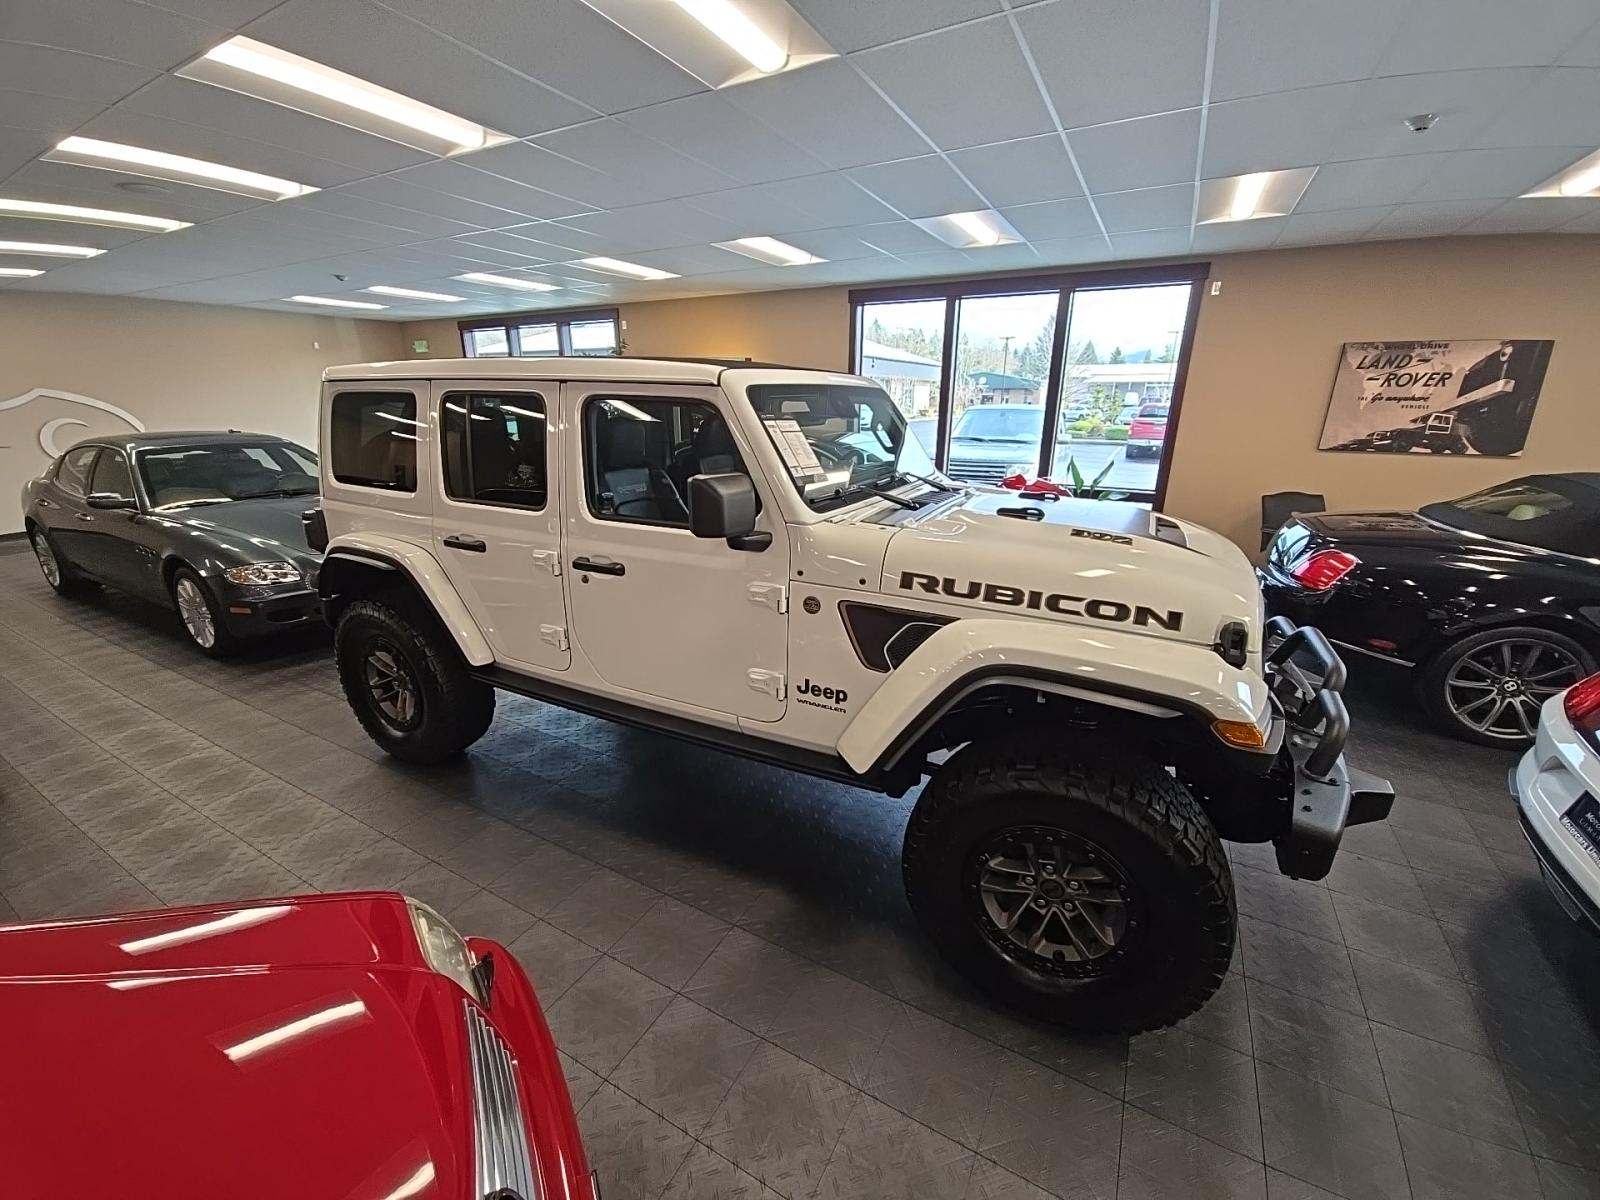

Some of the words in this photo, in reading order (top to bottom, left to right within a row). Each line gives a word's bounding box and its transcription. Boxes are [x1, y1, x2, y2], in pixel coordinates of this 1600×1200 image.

[1355, 354, 1414, 370] LAND
[1380, 372, 1453, 388] ROVER
[899, 571, 1184, 632] RUBICON
[796, 677, 848, 705] Jeep
[796, 697, 847, 714] WRANGLER
[1561, 815, 1589, 849] Motorcars
